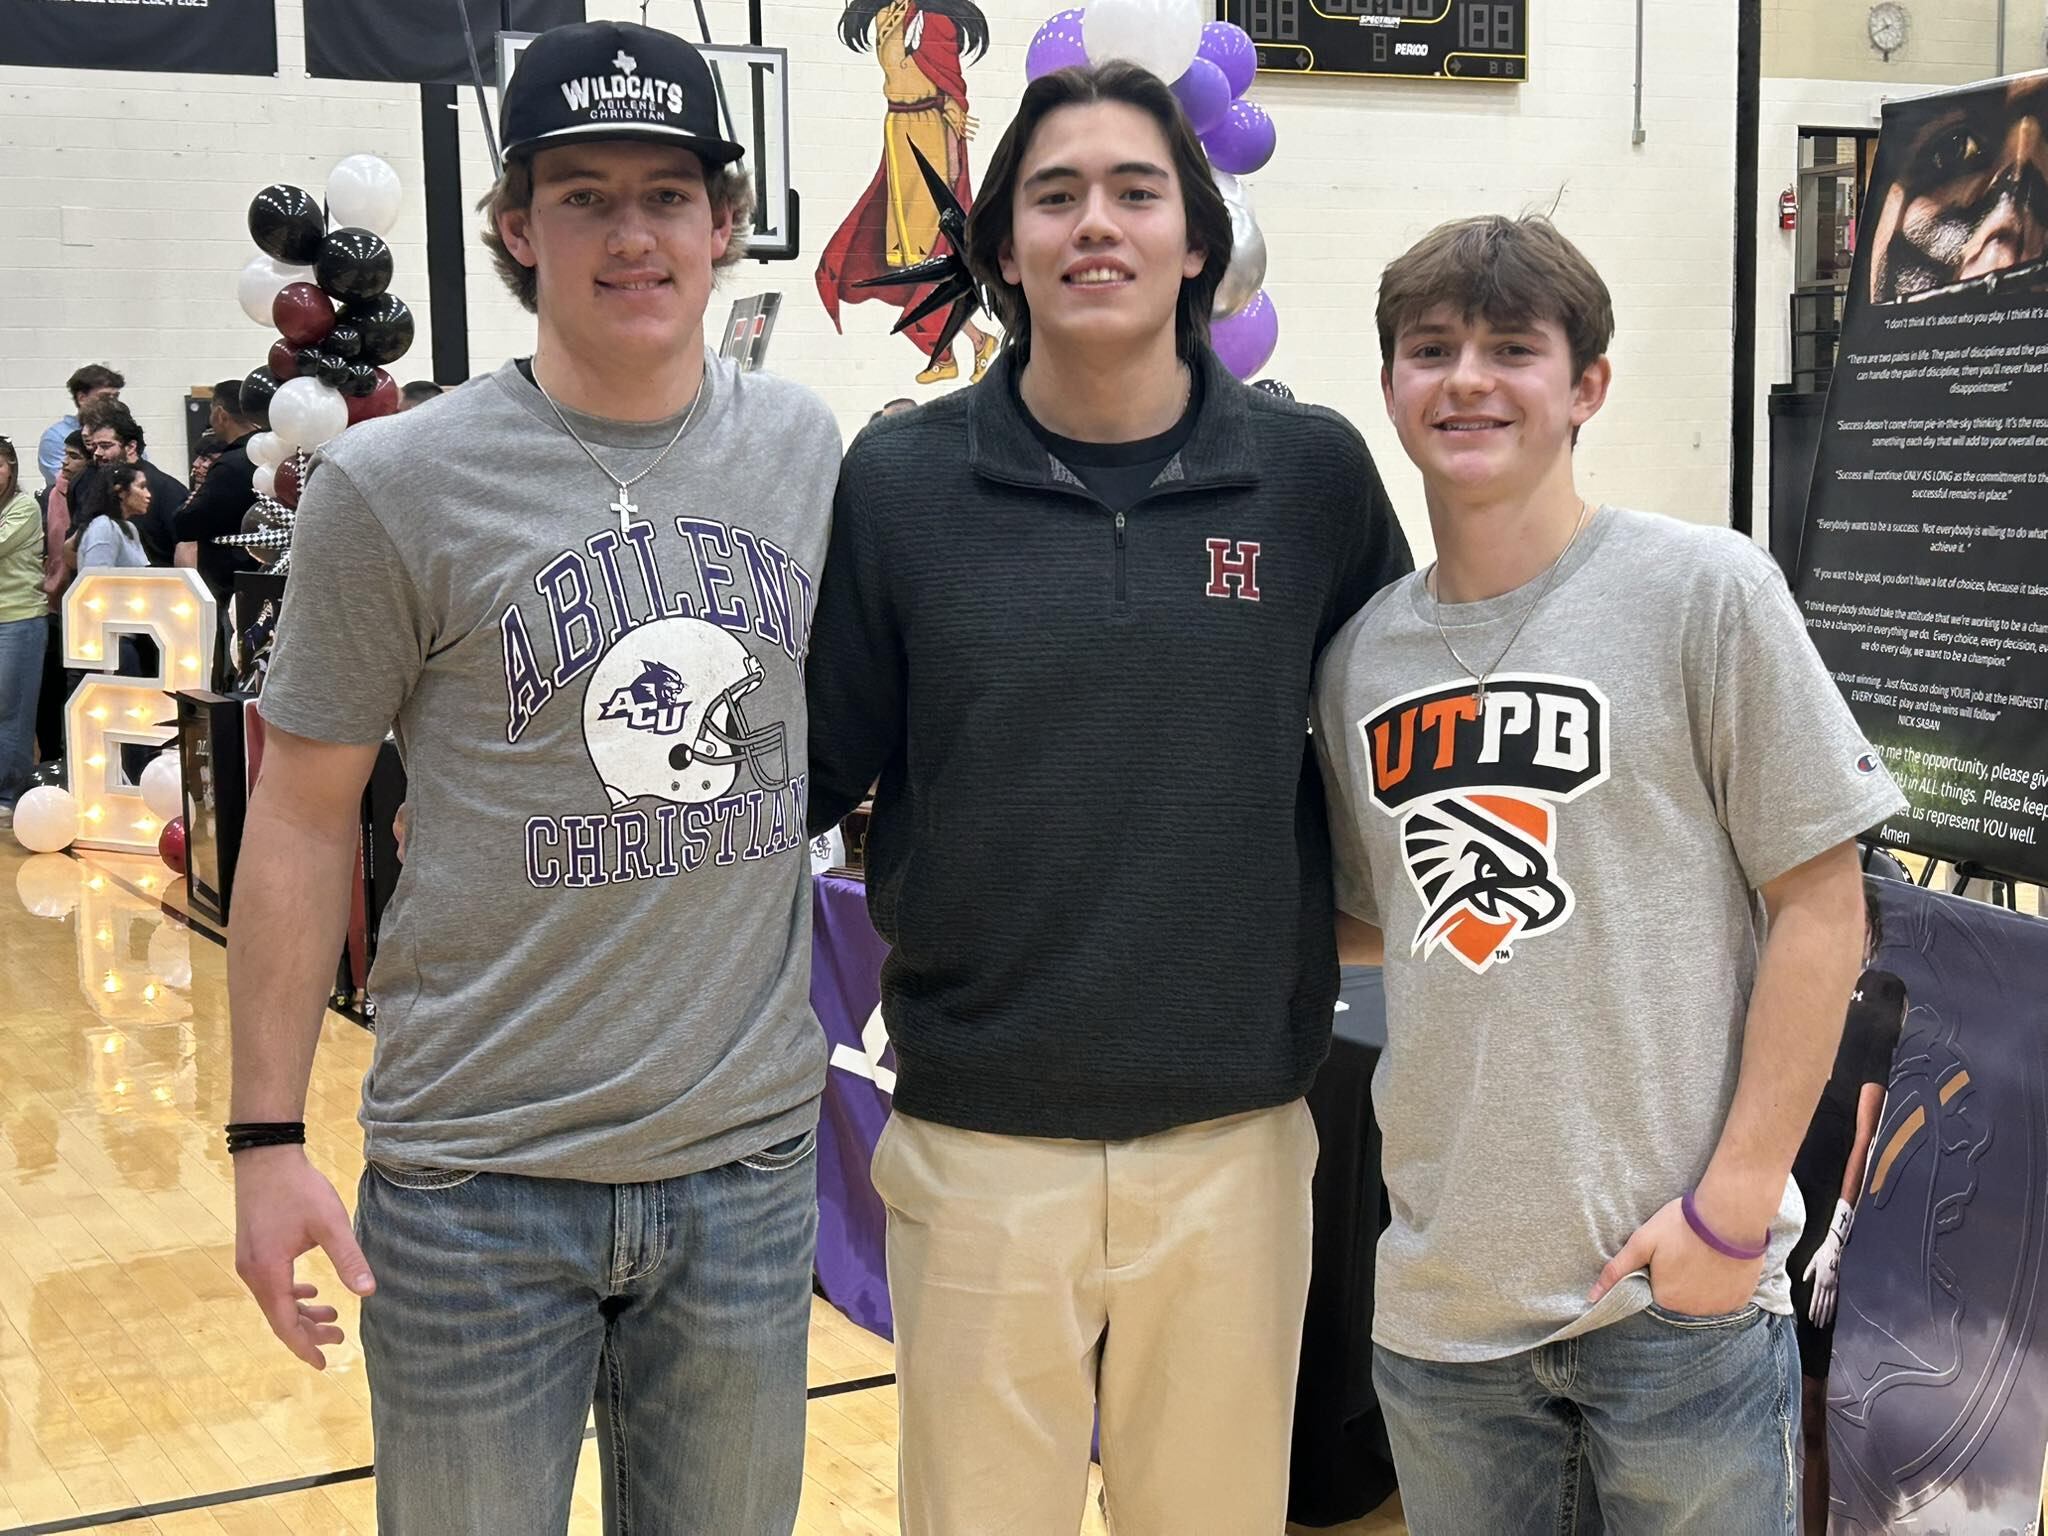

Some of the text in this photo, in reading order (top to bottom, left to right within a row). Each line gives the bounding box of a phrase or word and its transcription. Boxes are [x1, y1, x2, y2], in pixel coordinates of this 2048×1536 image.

[1394, 43, 1428, 57] PERIOD
[561, 75, 683, 114] WILDCATS
[597, 100, 656, 112] ABILENE
[589, 109, 665, 121] CHRISTIAN
[1206, 538, 1261, 602] H
[1896, 574, 1913, 585] don't
[1914, 576, 1931, 586] have
[1937, 577, 1947, 587] lot
[1810, 601, 1824, 611] think
[1880, 608, 1894, 618] take
[1894, 609, 1906, 619] the
[1935, 613, 1950, 623] that
[1951, 615, 1970, 625] we're
[1880, 644, 1898, 656] every
[1924, 650, 1942, 659] want
[1933, 630, 1953, 644] Every
[1980, 638, 2002, 650] every
[1836, 672, 1856, 684] about
[1884, 678, 1898, 689] Just
[1898, 679, 1918, 692] focus
[1919, 684, 1928, 692] on
[1929, 684, 1950, 699] doing
[1950, 687, 1971, 699] YOUR
[1970, 691, 1984, 702] job
[1985, 693, 1992, 702] at
[1994, 693, 2008, 704] the
[2008, 695, 2044, 709] HIGHEST
[597, 687, 694, 735] ACU
[1851, 690, 1873, 702] EVERY
[1873, 693, 1898, 707] SINGLE
[1898, 698, 1914, 711] play
[1914, 701, 1929, 711] and
[1929, 702, 1941, 713] the
[1942, 704, 1958, 716] wins
[1959, 707, 1972, 718] will
[1898, 715, 1940, 731] NICK SABAN
[1373, 691, 1590, 792] UTPB
[1886, 747, 1902, 760] me
[1904, 746, 1921, 763] the
[1922, 753, 1988, 779] opportunity,
[1991, 763, 2029, 783] please
[1908, 777, 1918, 791] in
[1919, 777, 1937, 797] ALL
[1941, 781, 1977, 805] things.
[1983, 790, 2020, 811] Please
[1880, 824, 1910, 845] Amen
[1913, 807, 1924, 820] us
[1926, 810, 1981, 832] represent
[1982, 818, 2008, 837] YOU
[2010, 827, 2036, 844] well.
[1495, 949, 1511, 960] TM
